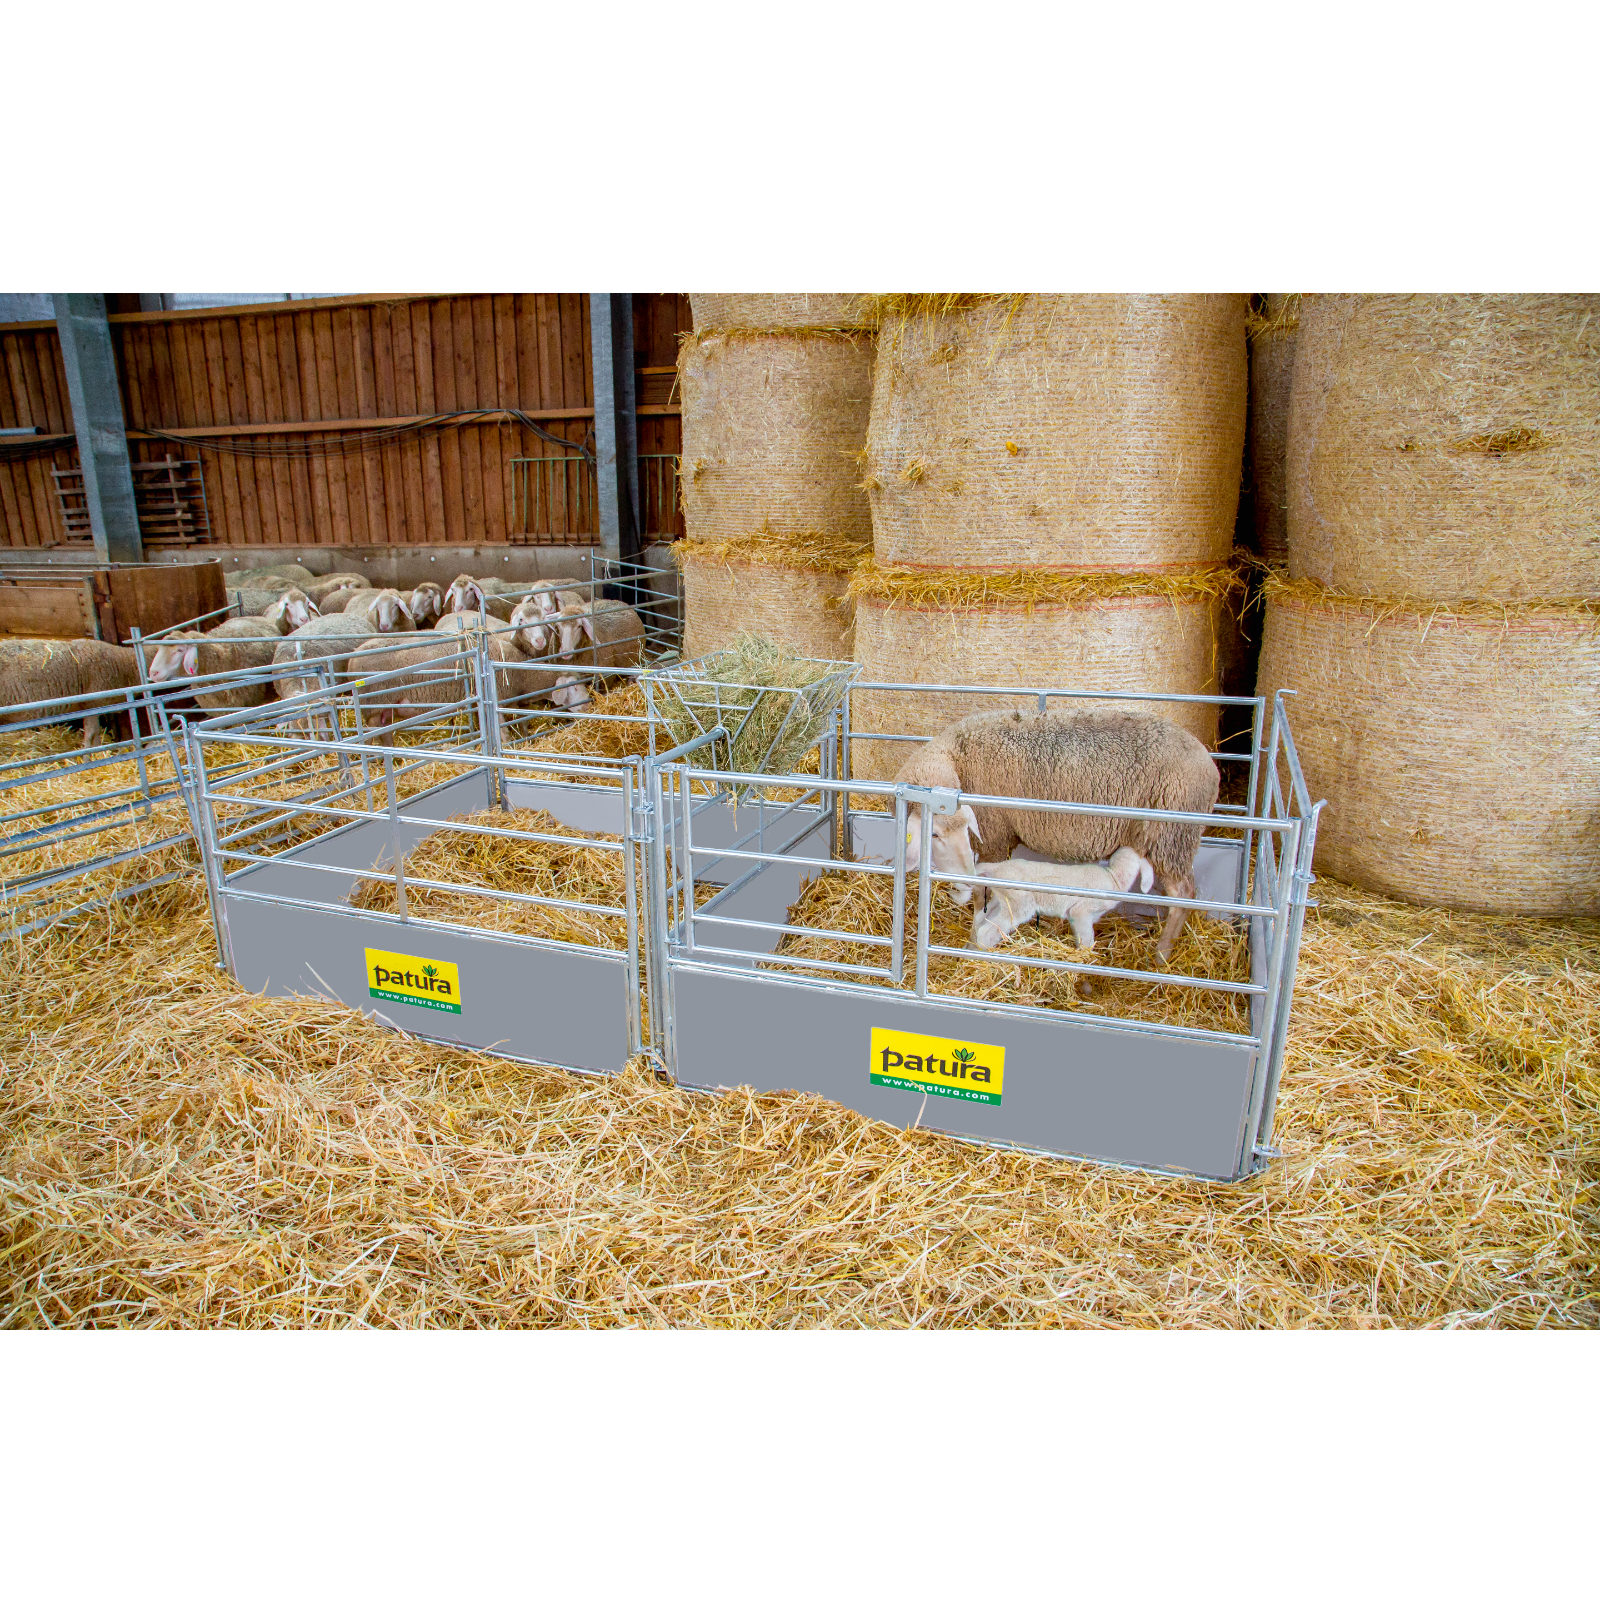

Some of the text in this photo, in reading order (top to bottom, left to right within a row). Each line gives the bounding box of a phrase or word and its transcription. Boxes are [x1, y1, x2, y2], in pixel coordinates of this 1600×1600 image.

[373, 964, 452, 995] patura
[377, 991, 454, 1011] www.patura.com
[880, 1046, 991, 1083] patura
[882, 1077, 990, 1101] www.patura.com
